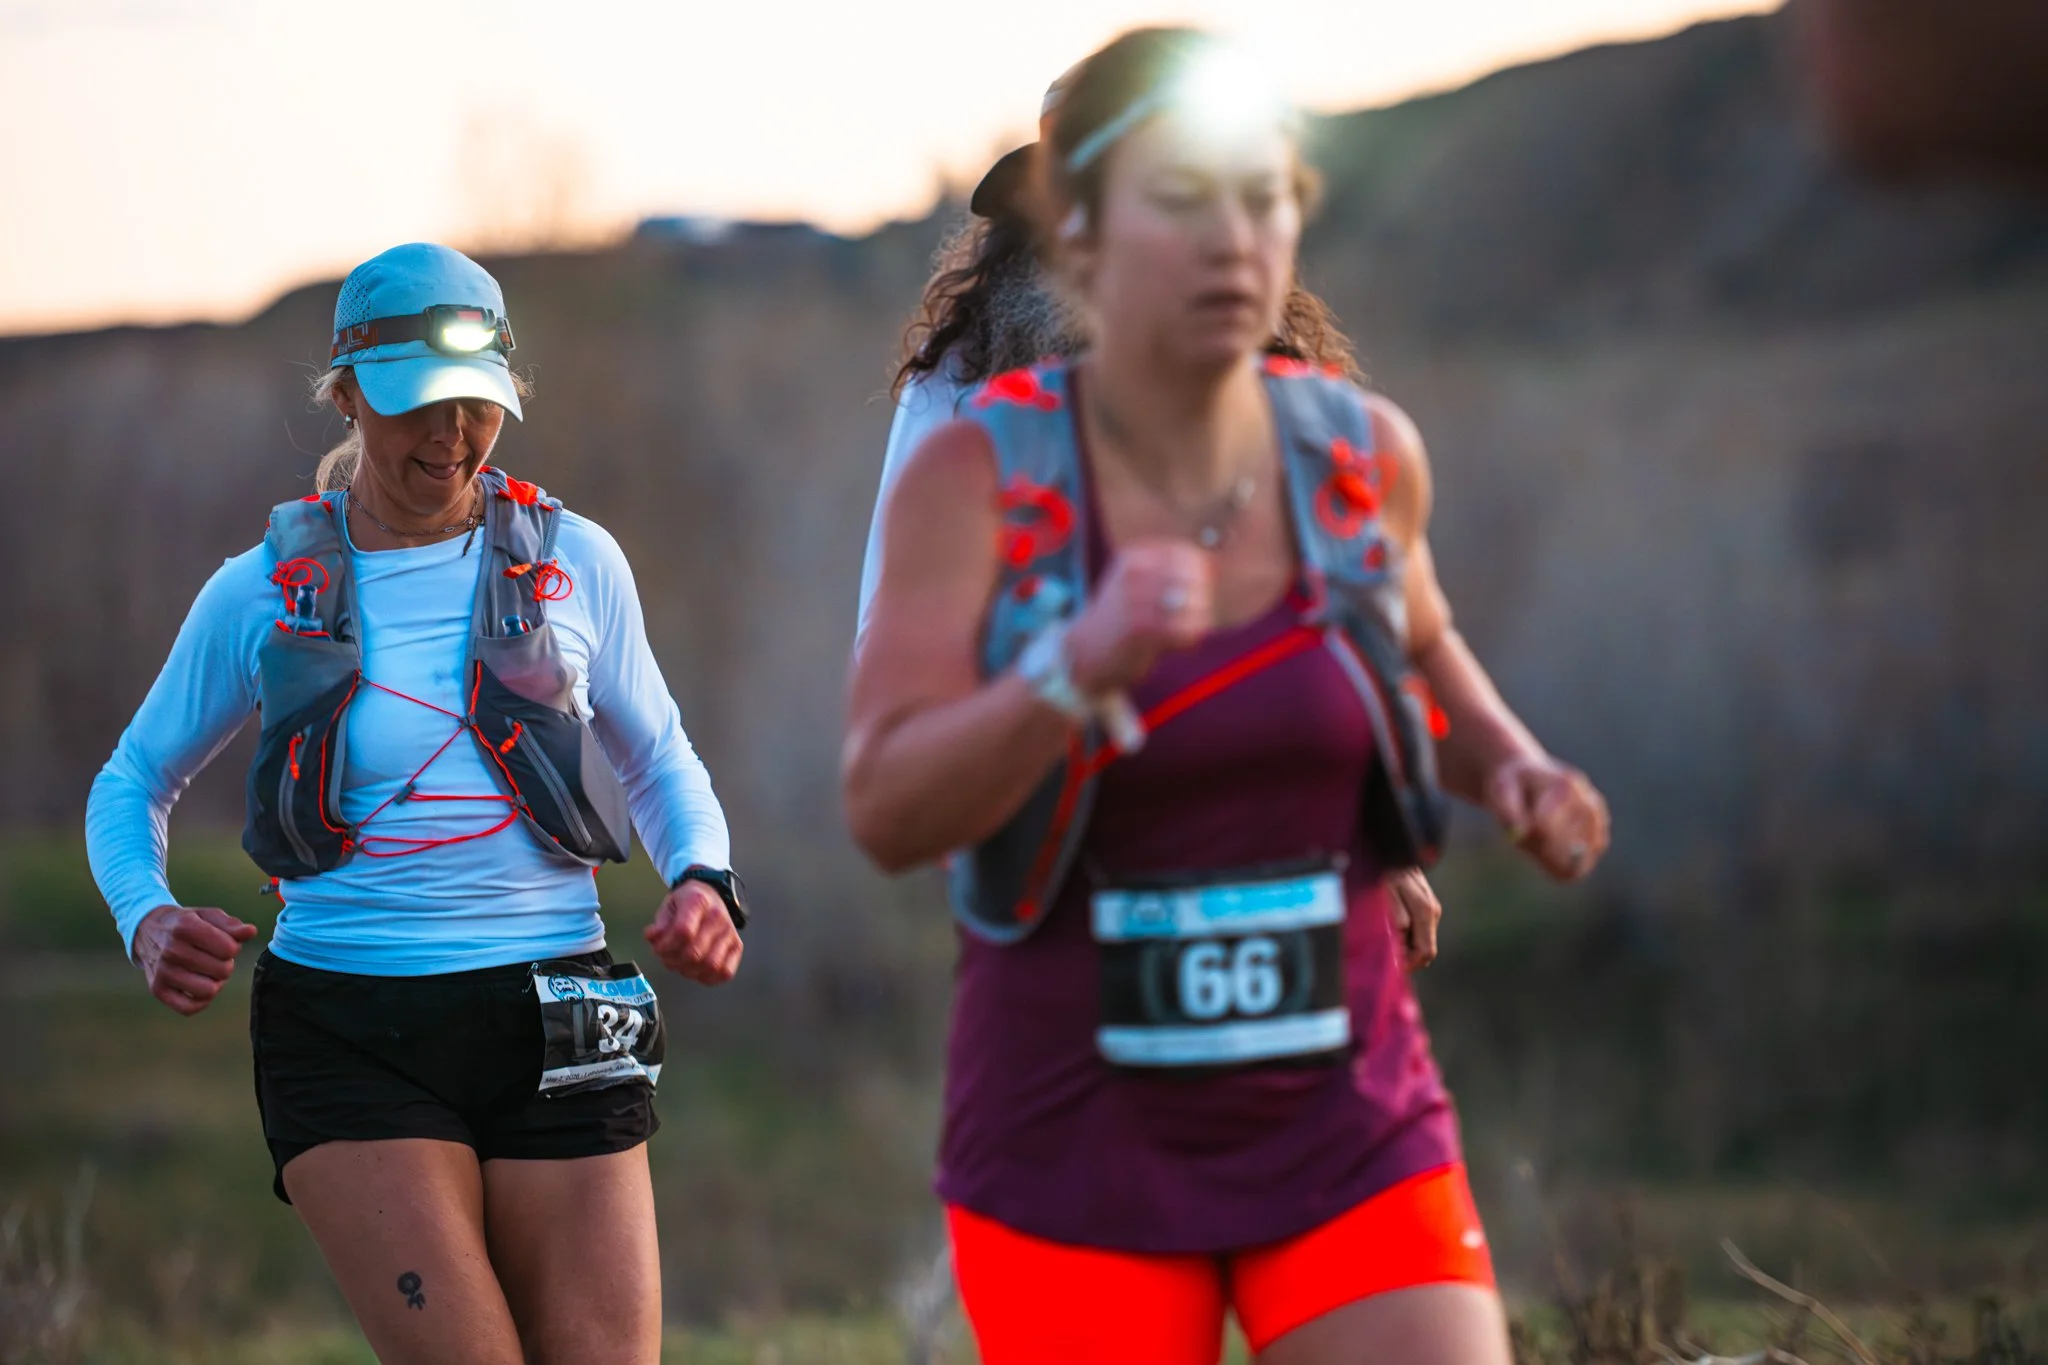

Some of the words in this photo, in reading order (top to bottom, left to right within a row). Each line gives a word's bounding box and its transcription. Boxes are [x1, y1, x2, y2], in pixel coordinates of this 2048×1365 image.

[633, 993, 654, 1004] ULTR
[1178, 937, 1282, 1018] 66
[598, 1004, 643, 1053] 34
